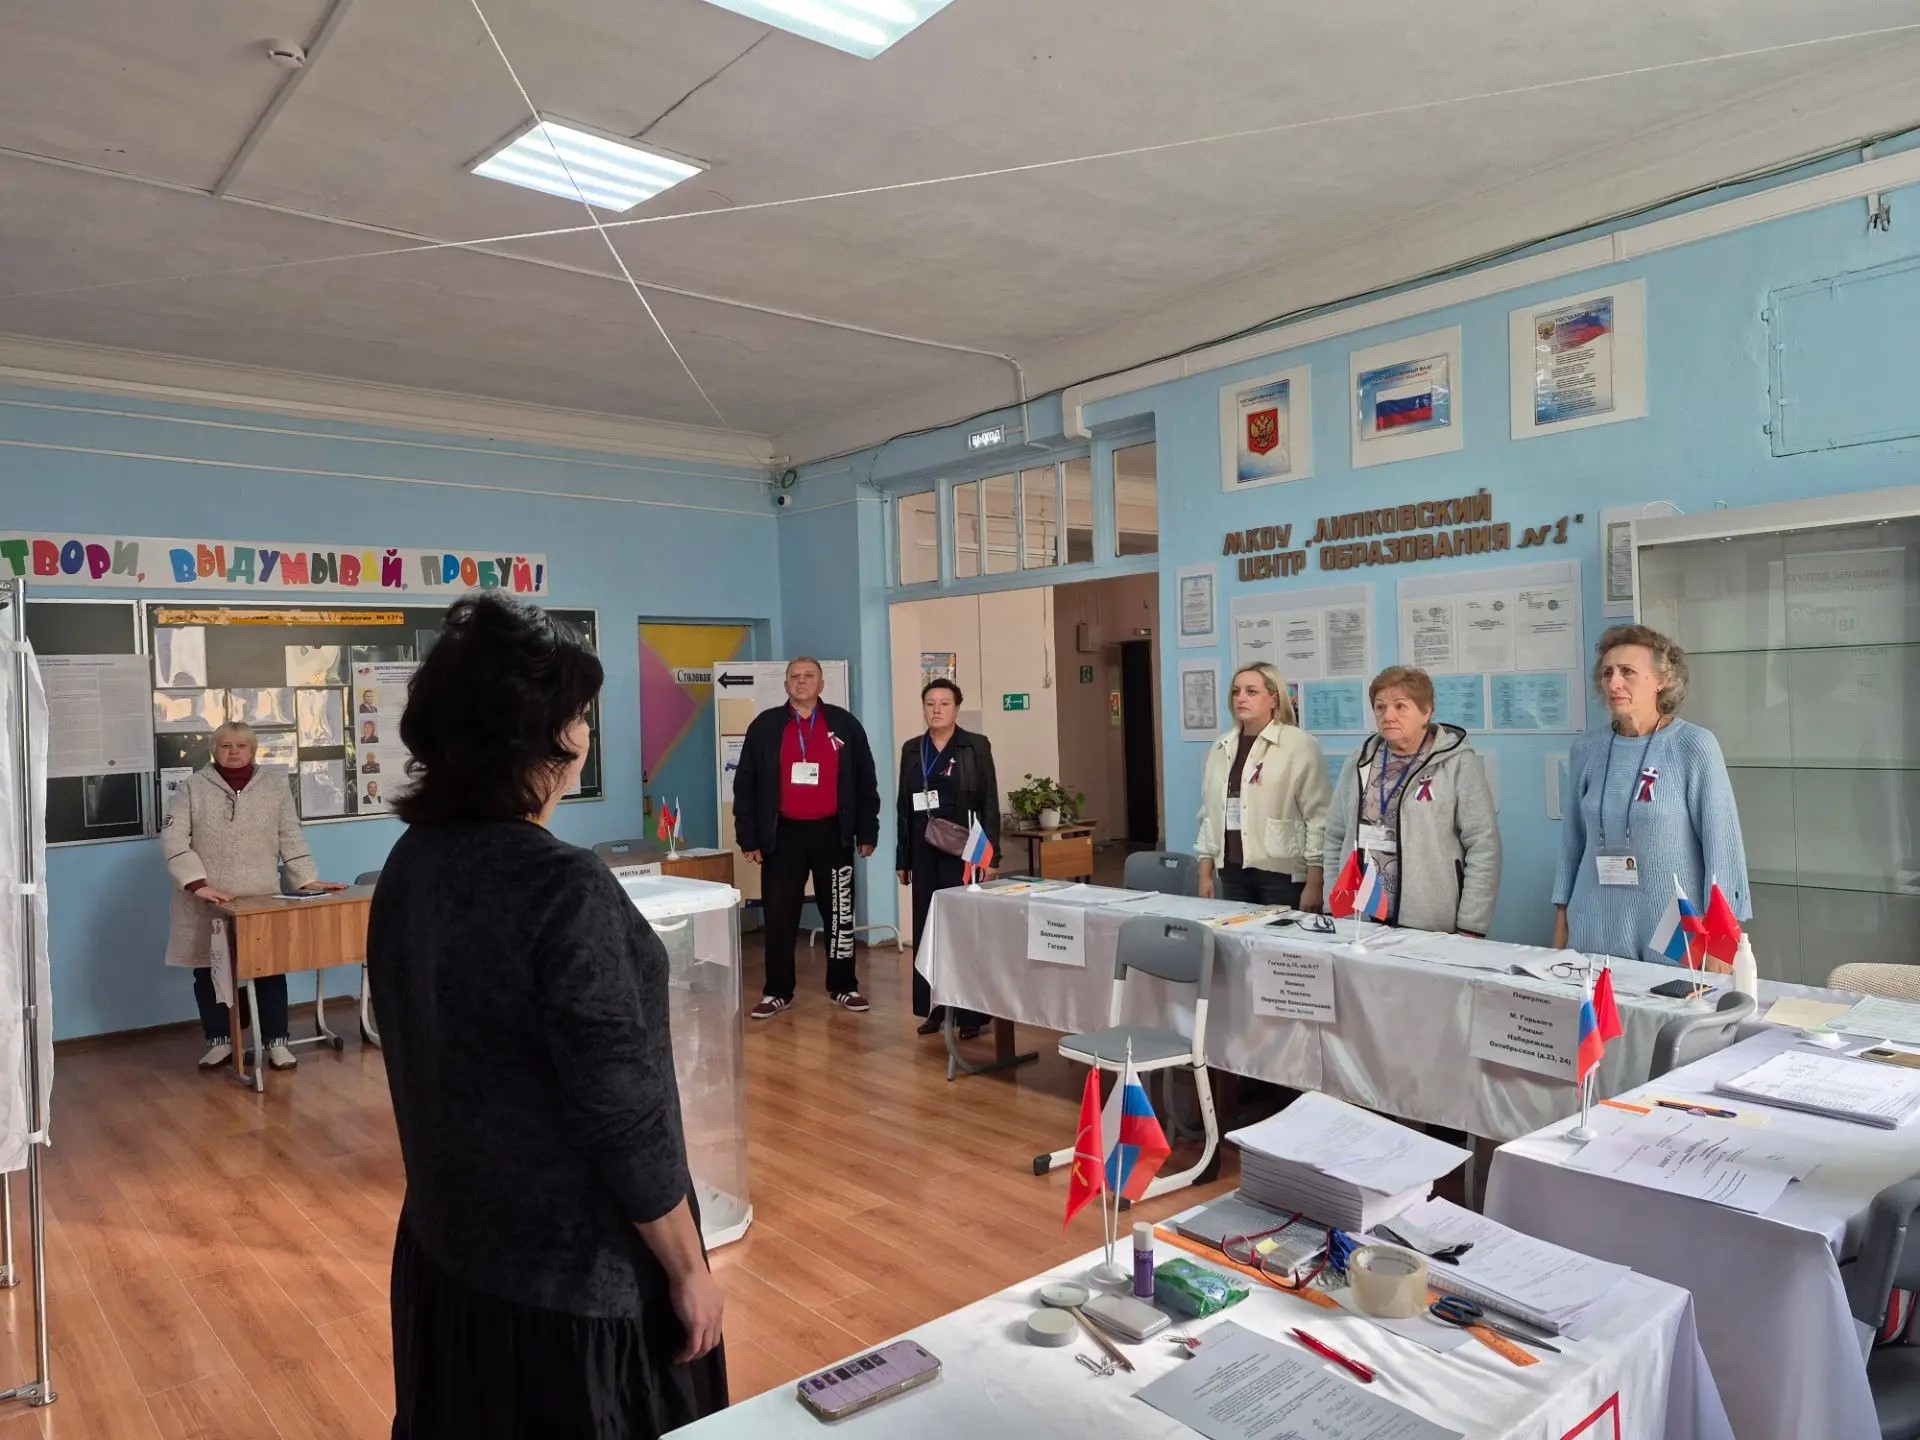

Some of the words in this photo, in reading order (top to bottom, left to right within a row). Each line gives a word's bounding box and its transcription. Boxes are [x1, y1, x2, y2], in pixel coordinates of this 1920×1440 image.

[972, 429, 1001, 446] ВЫХОД
[1223, 524, 1292, 555] МКОУ
[1238, 550, 1306, 582] ЦЕНТР
[1320, 522, 1511, 571] ОБРАЗОВАНИЯ
[0, 540, 146, 582] ТВОРИ,
[169, 544, 408, 592] ВЫДУМЫВАЙ,
[420, 554, 543, 593] ПРОБУЙ!
[677, 670, 711, 683] Столовая
[829, 938, 837, 959] GEAR
[1520, 1014, 1554, 1027] Горького
[1517, 1025, 1545, 1037] Улицы:
[1489, 1040, 1536, 1057] Октябрьская
[1507, 1033, 1554, 1050] Набережная
